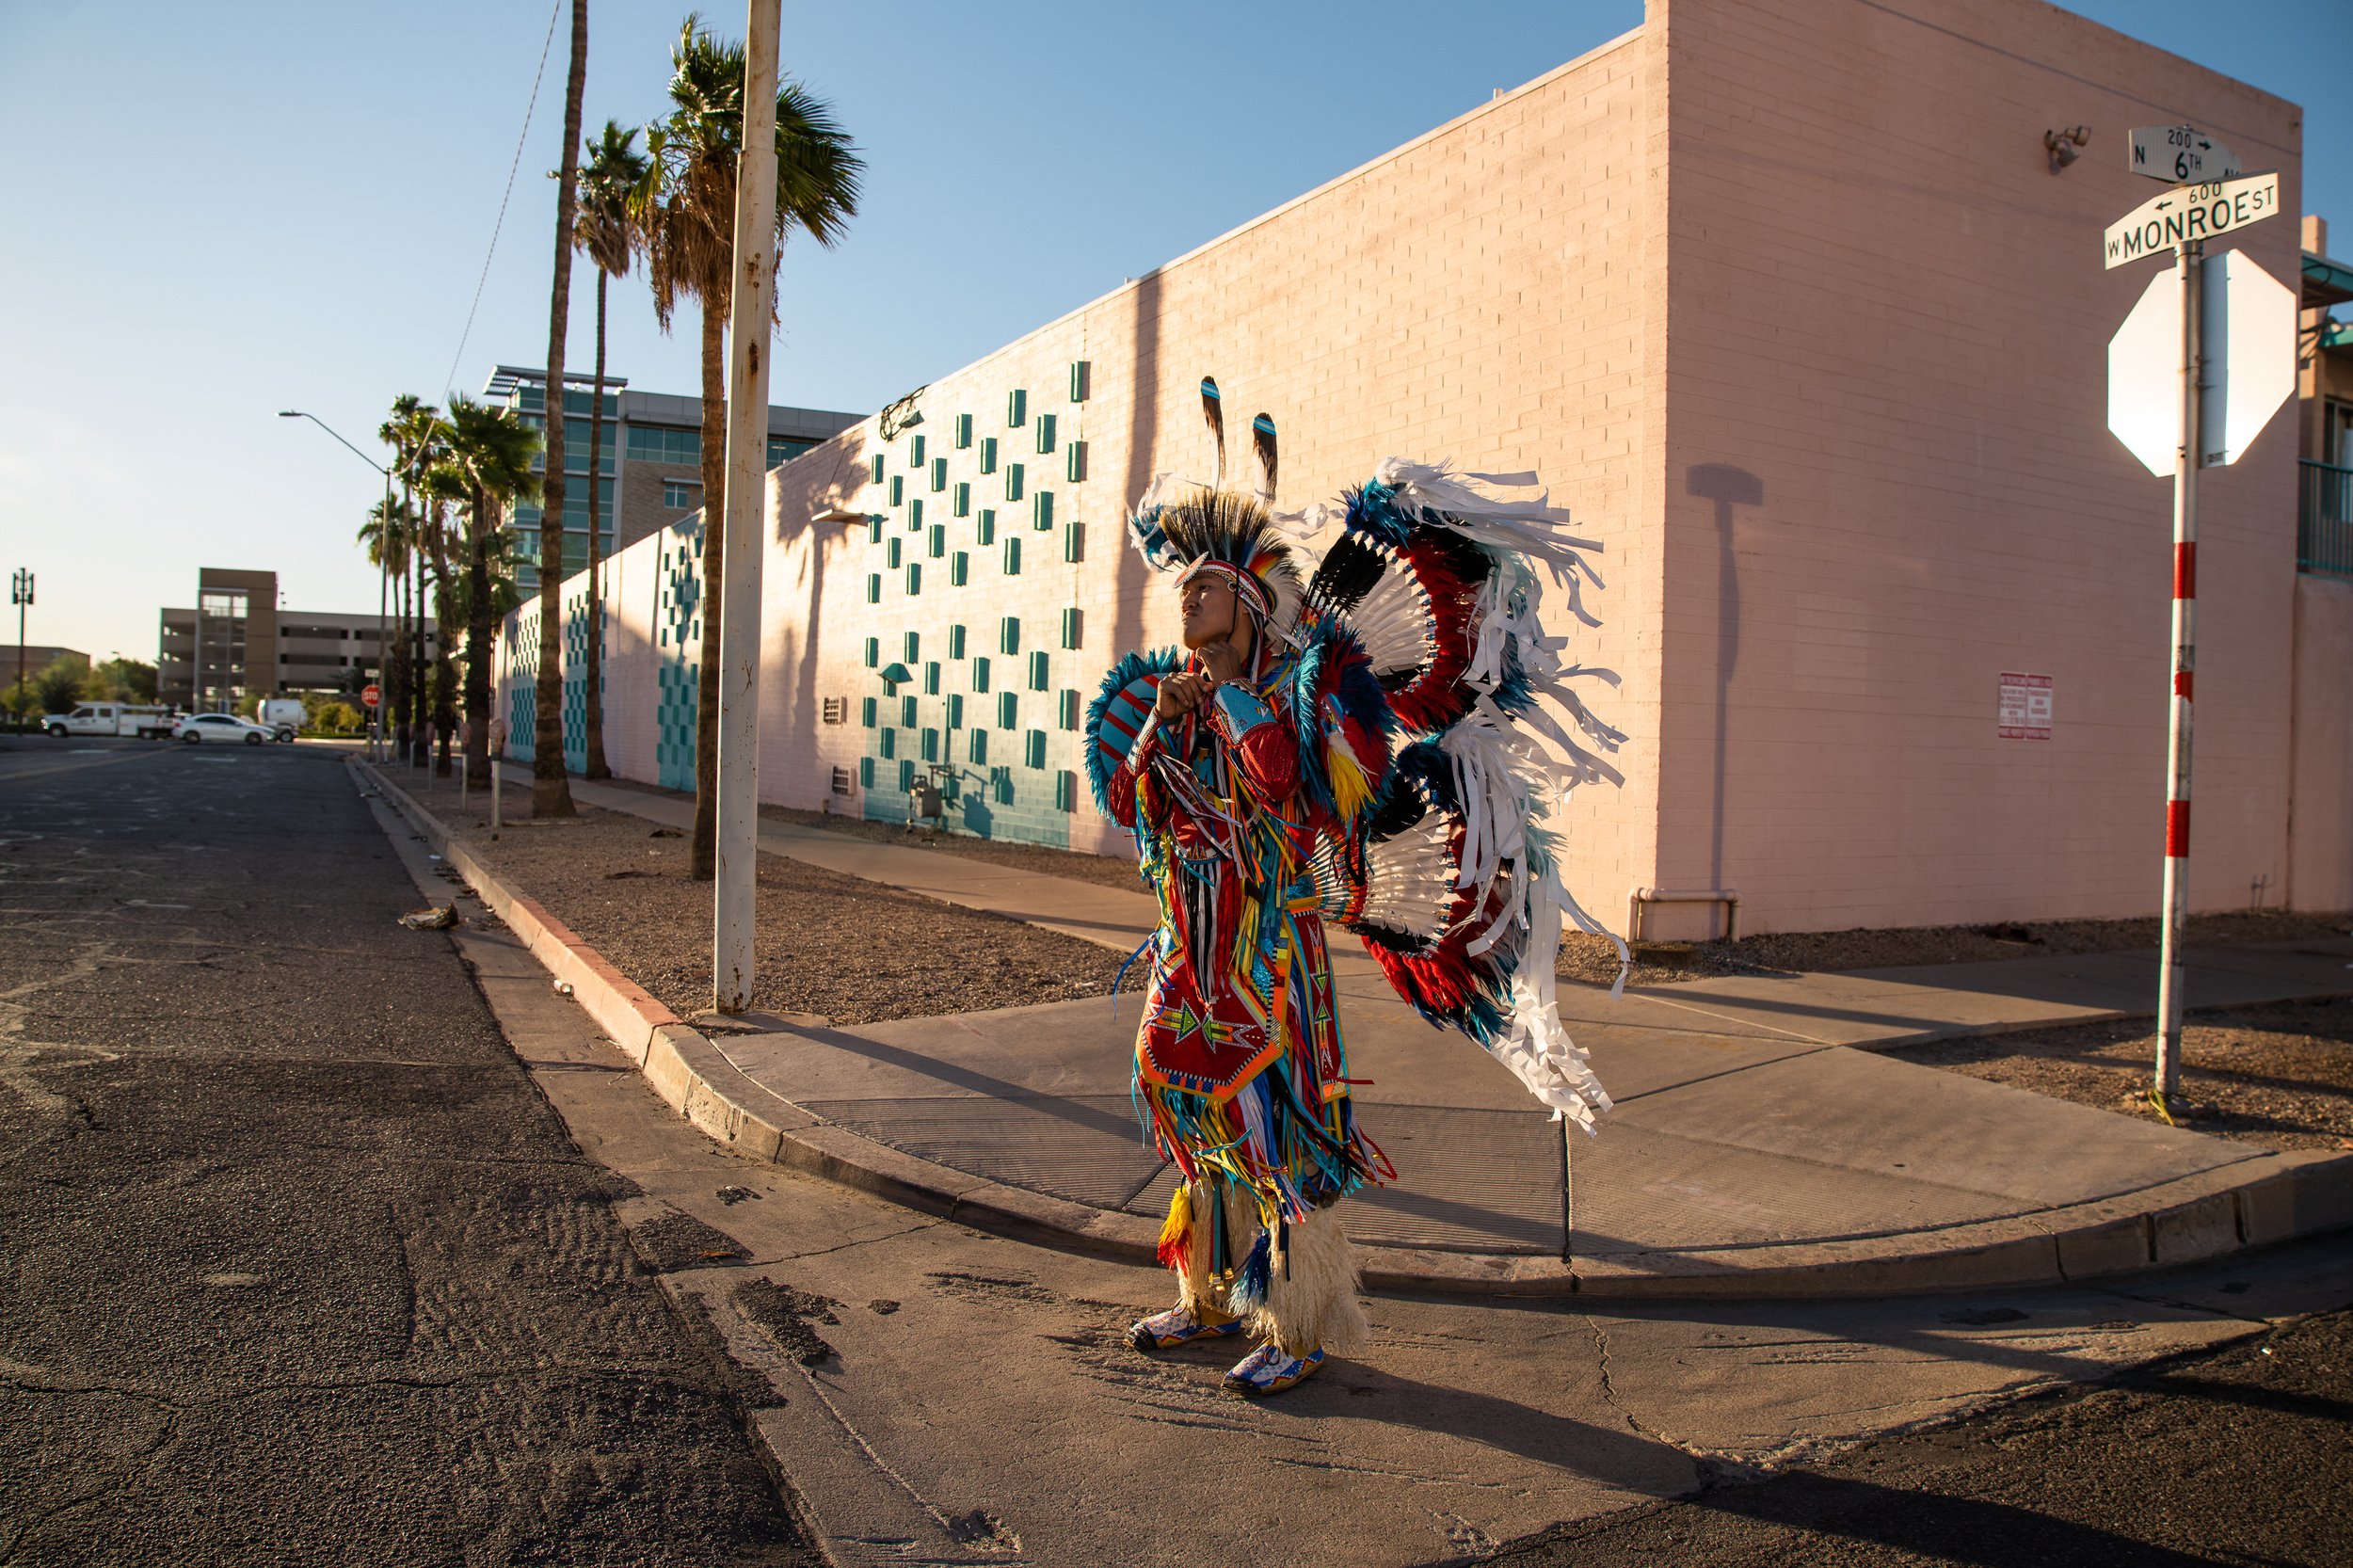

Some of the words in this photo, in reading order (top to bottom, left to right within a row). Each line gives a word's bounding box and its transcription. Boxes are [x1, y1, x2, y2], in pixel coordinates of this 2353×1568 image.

[2168, 129, 2192, 149] 200
[2135, 145, 2145, 164] N
[2174, 151, 2202, 180] 6TH
[2189, 181, 2221, 203] 600
[2107, 239, 2120, 259] W
[2124, 190, 2250, 259] MONROE
[2252, 184, 2275, 210] ST
